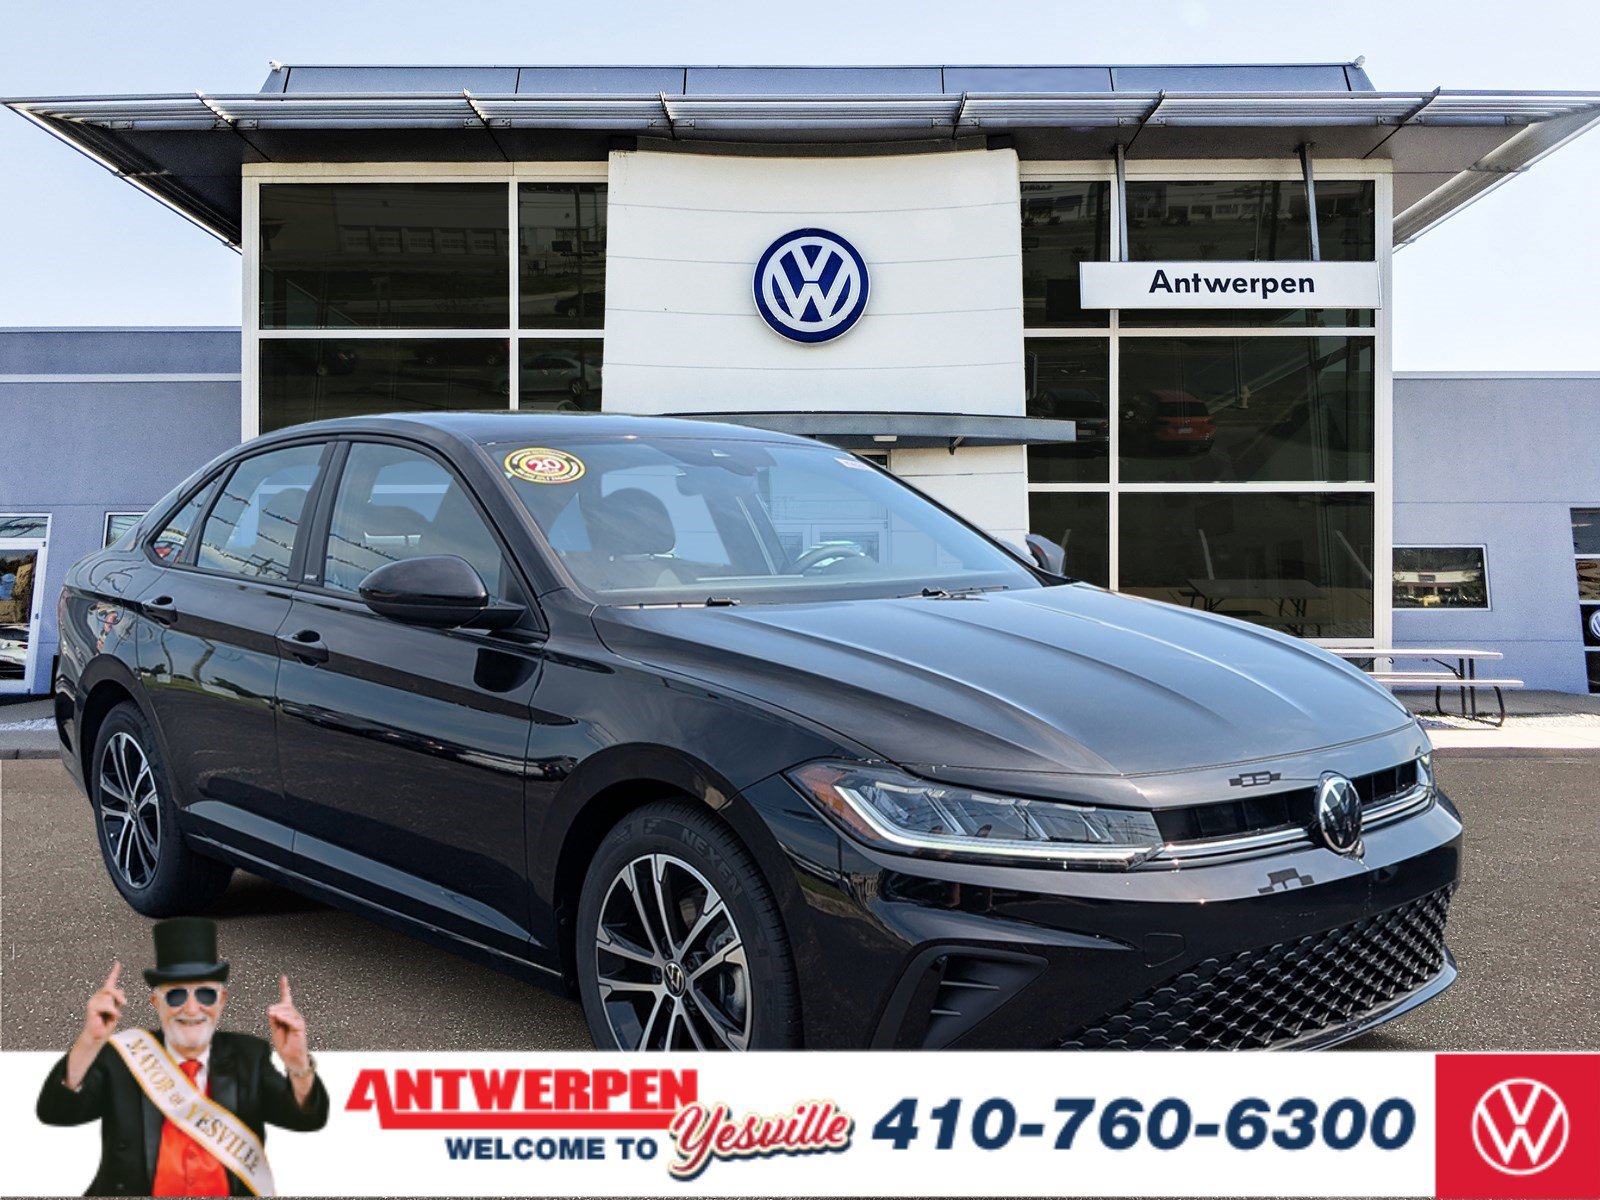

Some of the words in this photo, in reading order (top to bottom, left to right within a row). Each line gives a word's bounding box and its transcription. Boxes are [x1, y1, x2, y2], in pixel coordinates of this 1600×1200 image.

[1149, 269, 1315, 299] Antwerpen
[527, 458, 561, 472] 20
[681, 828, 743, 895] NEXEN
